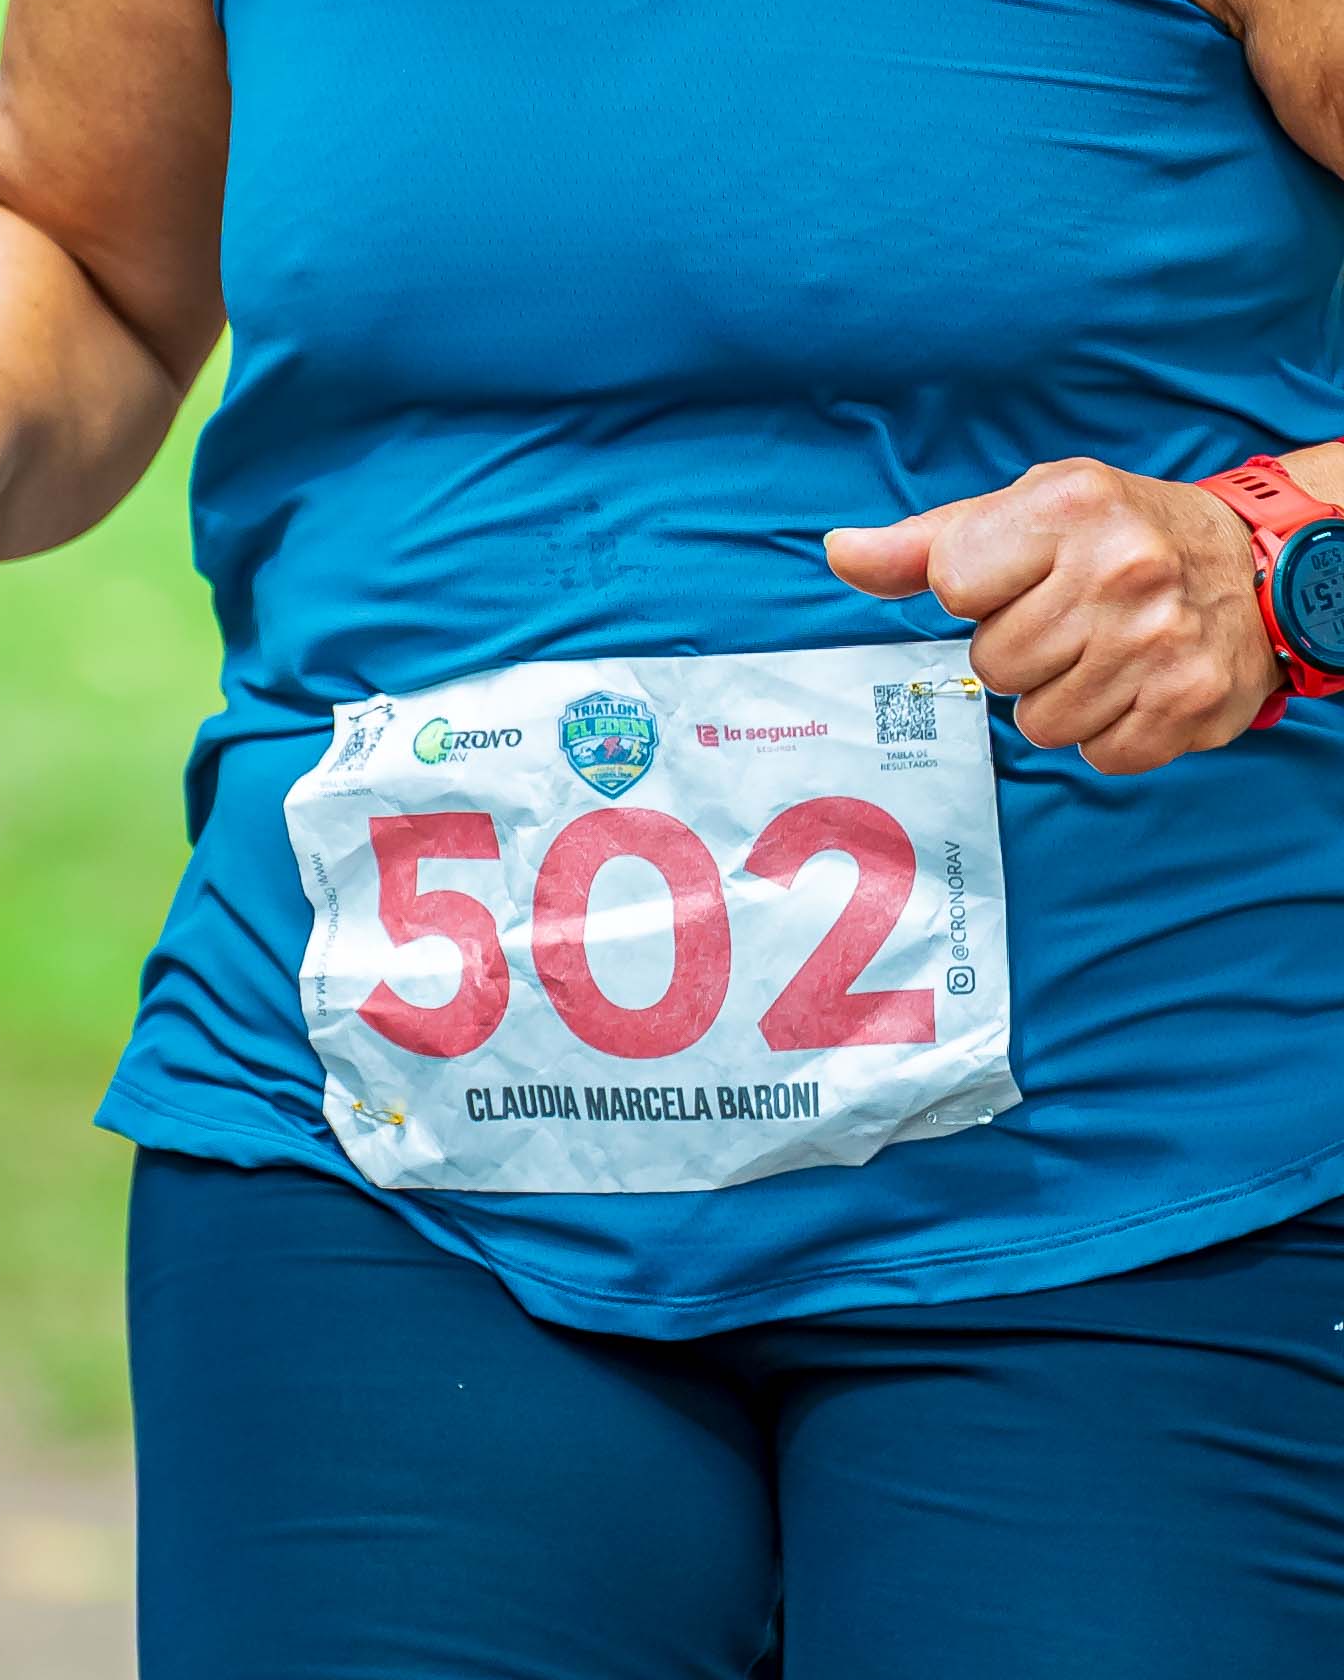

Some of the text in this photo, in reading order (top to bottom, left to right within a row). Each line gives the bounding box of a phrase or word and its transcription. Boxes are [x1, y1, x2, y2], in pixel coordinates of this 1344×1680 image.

[573, 703, 639, 718] TRIATLON
[567, 717, 649, 740] EL EDEN
[723, 720, 829, 743] la segunda
[437, 752, 468, 764] RAV
[880, 760, 938, 772] RESULTADOS
[944, 840, 969, 961] @CRONORAV
[356, 796, 936, 1060] 502
[465, 1081, 820, 1122] CLAUDIA MARCELA BARONI
